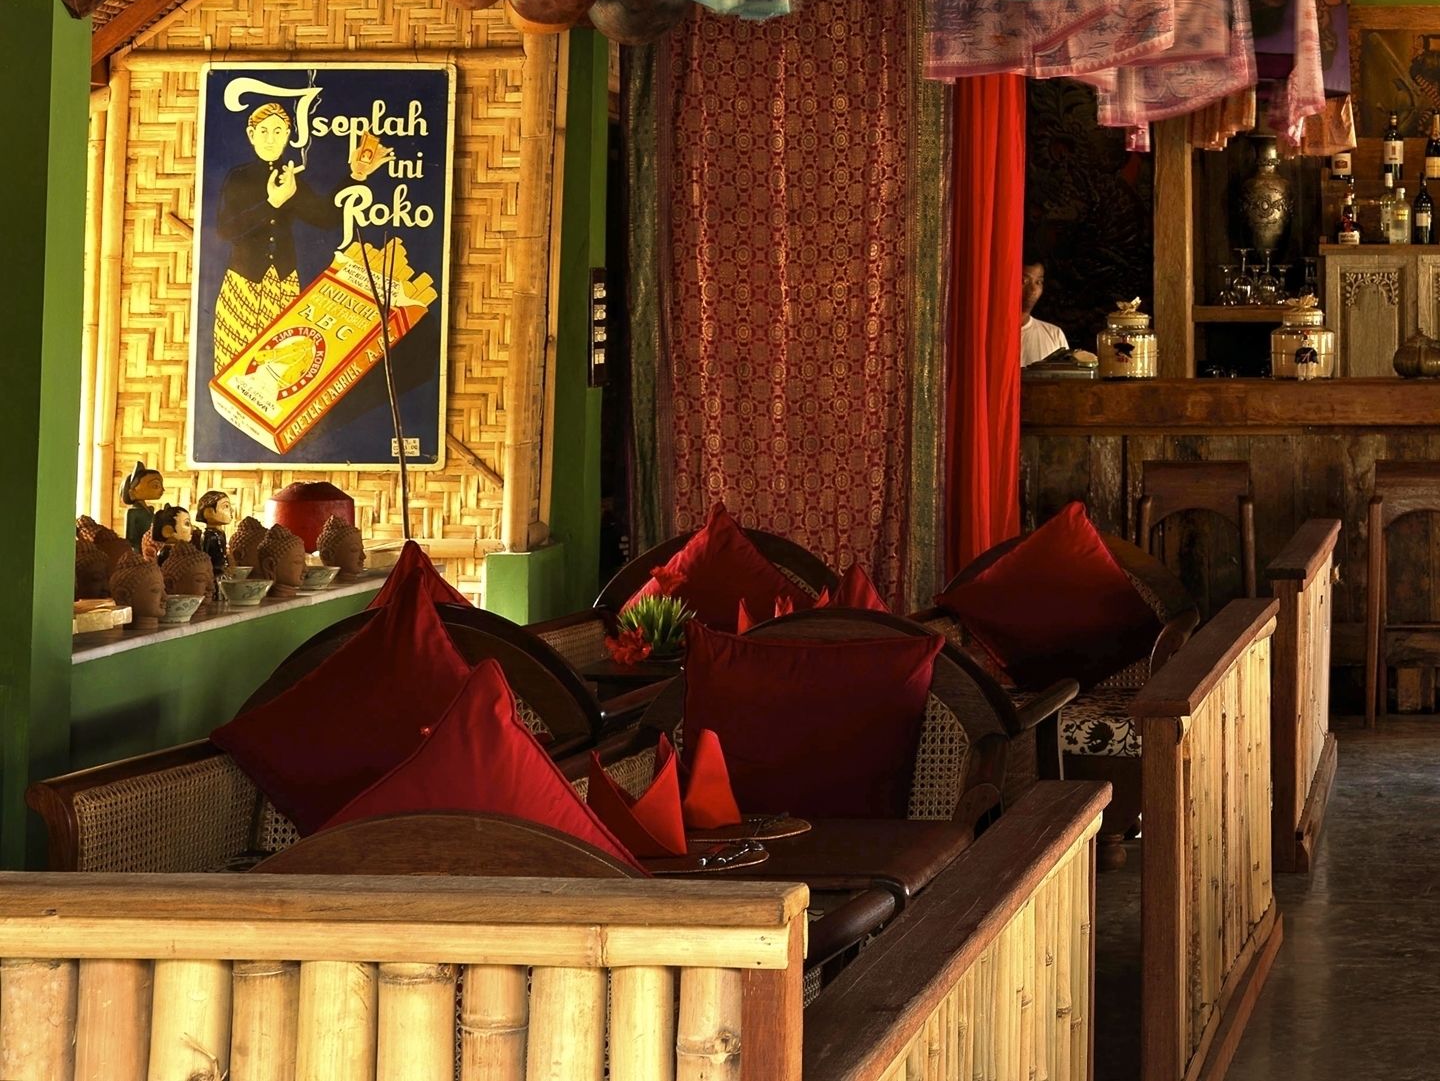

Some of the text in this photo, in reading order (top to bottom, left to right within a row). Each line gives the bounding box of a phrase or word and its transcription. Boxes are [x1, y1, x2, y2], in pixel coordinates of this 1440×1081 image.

[388, 151, 424, 179] ini
[334, 183, 434, 250] Roko
[319, 284, 379, 322] INDISCHE
[272, 327, 324, 378] TJAP TAPEL KOEDA
[283, 399, 323, 445] KRETEK
[321, 362, 362, 406] FABRIEK
